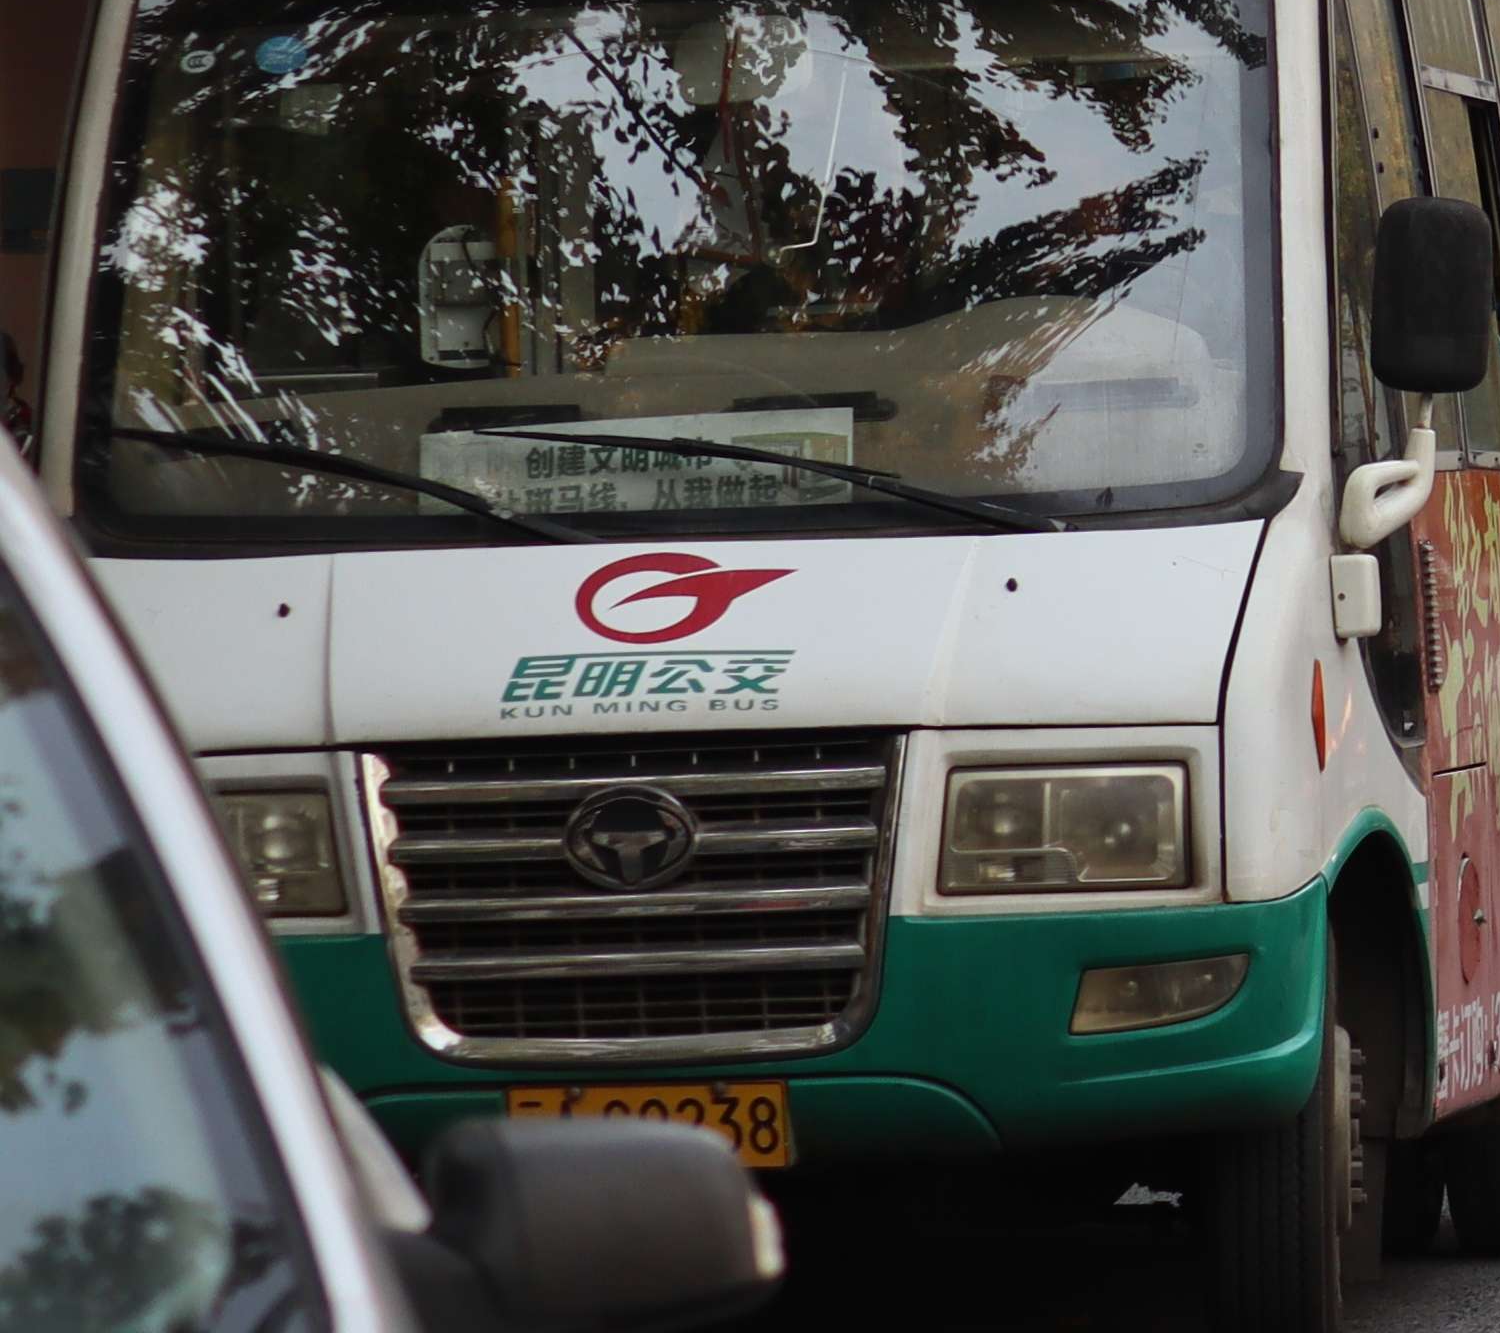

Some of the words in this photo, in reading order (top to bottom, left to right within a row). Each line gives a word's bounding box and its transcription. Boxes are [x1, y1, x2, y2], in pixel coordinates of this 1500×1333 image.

[501, 650, 797, 703] 昆明公交
[500, 704, 573, 720] KUN
[592, 700, 688, 715] MING
[708, 698, 780, 712] BUS
